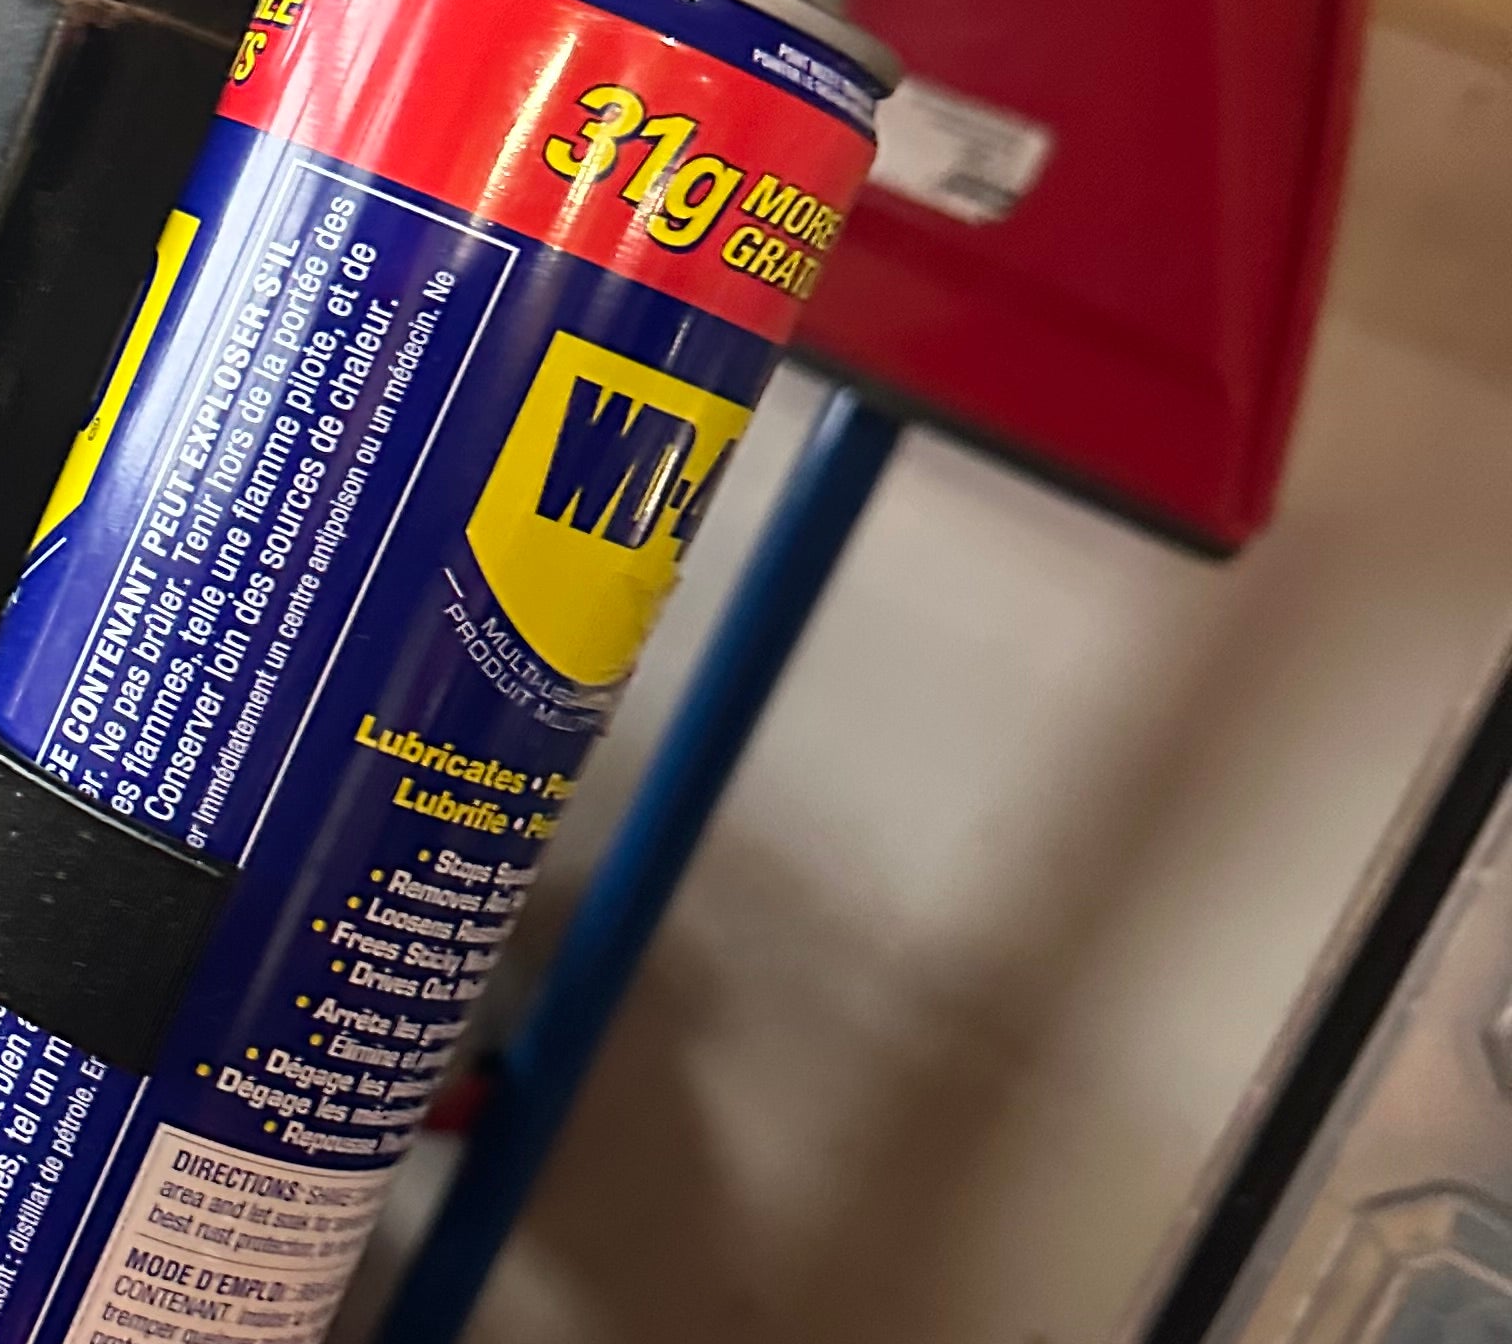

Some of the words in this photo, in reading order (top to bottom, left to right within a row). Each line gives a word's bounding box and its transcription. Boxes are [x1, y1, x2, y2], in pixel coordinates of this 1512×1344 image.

[542, 83, 732, 248] 31g
[308, 196, 356, 251] des
[339, 242, 377, 281] de
[422, 271, 456, 303] Ne
[265, 252, 329, 352] portée
[327, 283, 360, 317] et
[251, 353, 288, 382] la
[285, 328, 347, 415] pilote,
[382, 310, 441, 403] médecin.
[237, 386, 272, 424] de
[368, 404, 397, 434] un
[204, 428, 254, 493] hors
[231, 415, 301, 523] flamme
[355, 435, 382, 465] ou
[61, 555, 158, 744] CONTENANT
[140, 468, 195, 557] PEUT
[174, 297, 271, 470] EXPLOSER
[247, 227, 301, 299] S'IL
[170, 490, 224, 565] Tenir
[308, 467, 369, 573] antipoison
[143, 681, 225, 821] Conserver
[203, 629, 251, 682] loin
[232, 572, 275, 625] des
[259, 457, 326, 570] sources
[309, 415, 344, 453] de
[329, 299, 399, 411] chaleur.
[210, 527, 252, 582] une
[131, 577, 192, 664] brûler.
[177, 585, 232, 646] telle
[278, 573, 320, 639] centre
[264, 641, 291, 669] un
[442, 602, 538, 707] PRODUIT
[112, 665, 151, 722] pas
[121, 653, 204, 778] flammes,
[89, 721, 127, 762] Ne
[354, 714, 527, 794] Lubricates
[392, 777, 508, 835] Lubrifie
[3, 1103, 41, 1144] tel
[25, 1067, 59, 1106] un
[216, 1066, 313, 1117] Dégage
[7, 1182, 53, 1253] distillat
[37, 1155, 64, 1183] de
[51, 1086, 97, 1158] pétrole.
[158, 1179, 206, 1208] area
[146, 1201, 195, 1234] best
[123, 1246, 195, 1285] MODE
